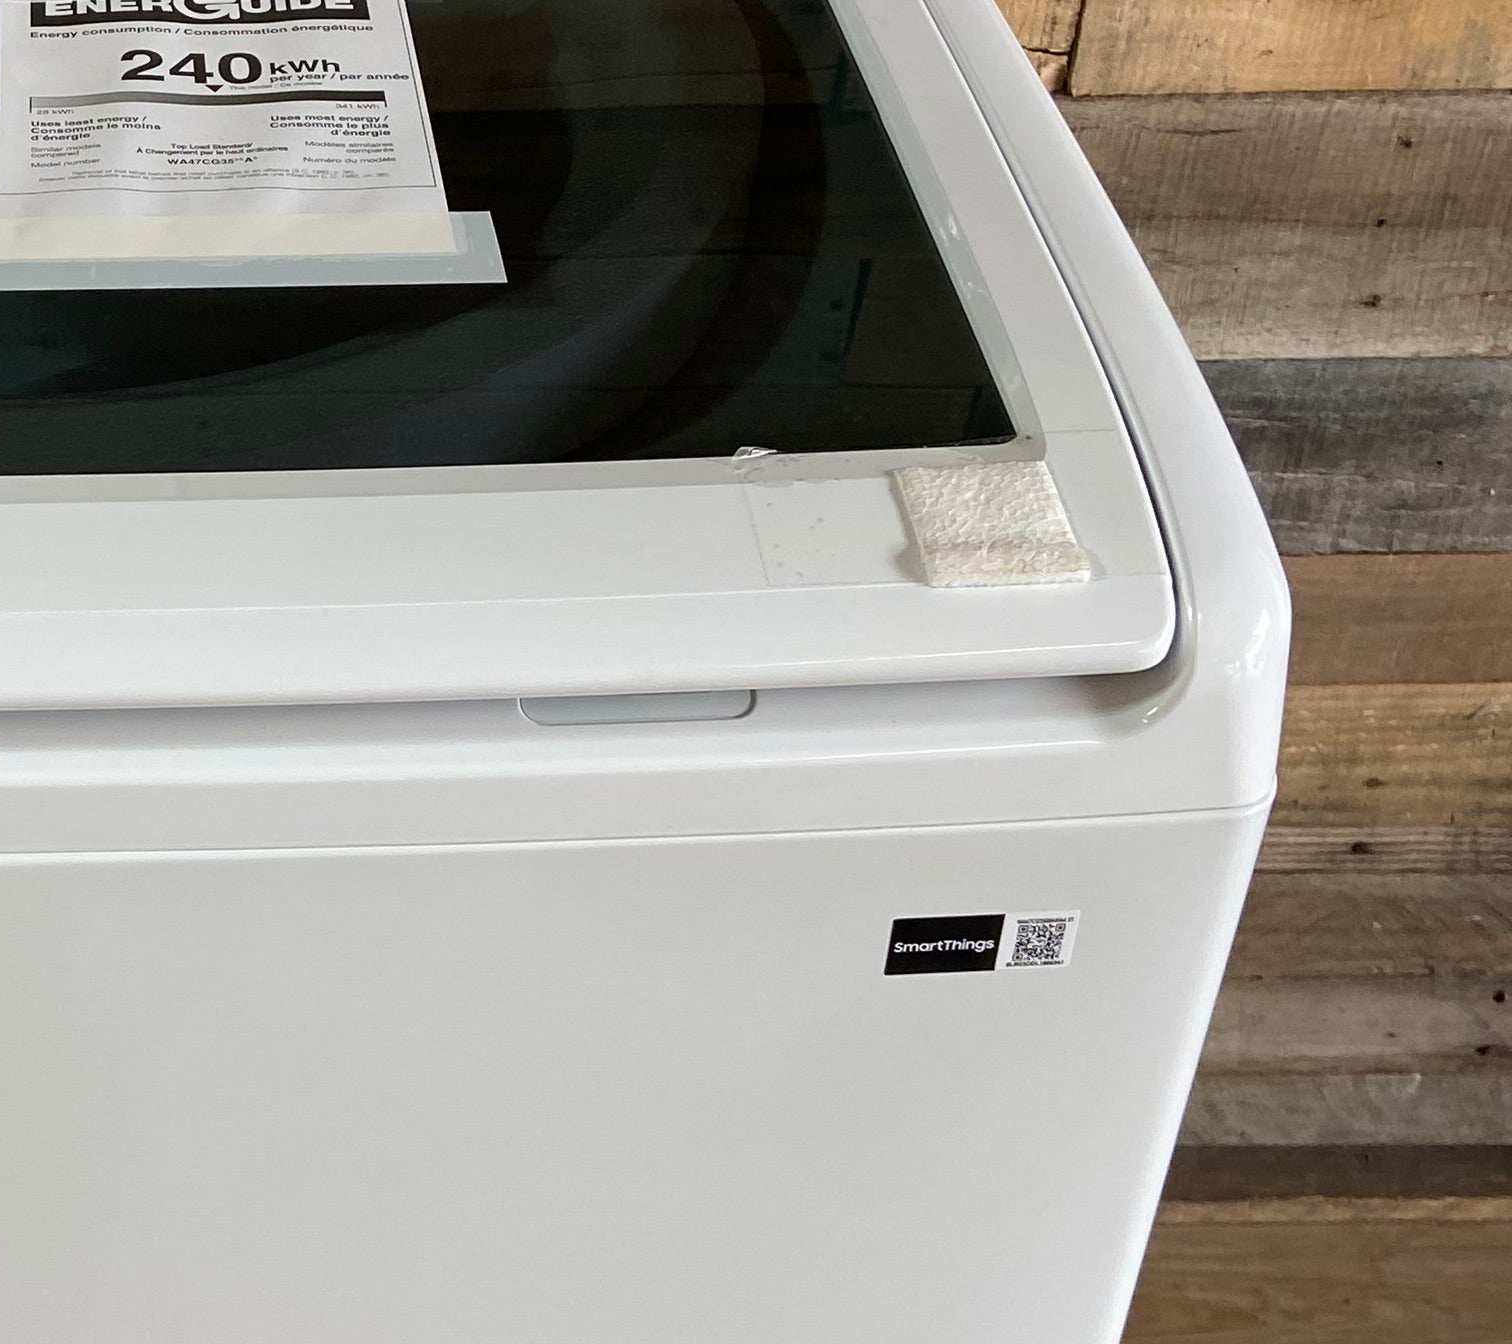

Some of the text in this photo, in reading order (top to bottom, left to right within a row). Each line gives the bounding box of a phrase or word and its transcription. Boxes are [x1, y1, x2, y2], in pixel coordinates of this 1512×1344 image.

[31, 31, 78, 39] Energy
[82, 27, 171, 36] consumption
[184, 28, 288, 36] Consommation
[292, 24, 373, 34] énergétique
[121, 49, 262, 85] 240
[269, 59, 341, 75] kWh
[270, 75, 293, 84] per
[297, 74, 327, 82] year
[340, 74, 364, 82] par
[366, 73, 409, 81] année
[65, 118, 94, 126] least
[97, 116, 140, 124] energy
[270, 114, 301, 122] Uses
[338, 115, 380, 123] energy
[30, 125, 104, 134] Consomme
[122, 122, 161, 130] moins
[361, 122, 389, 130] plus
[893, 938, 996, 954] SmartThings
